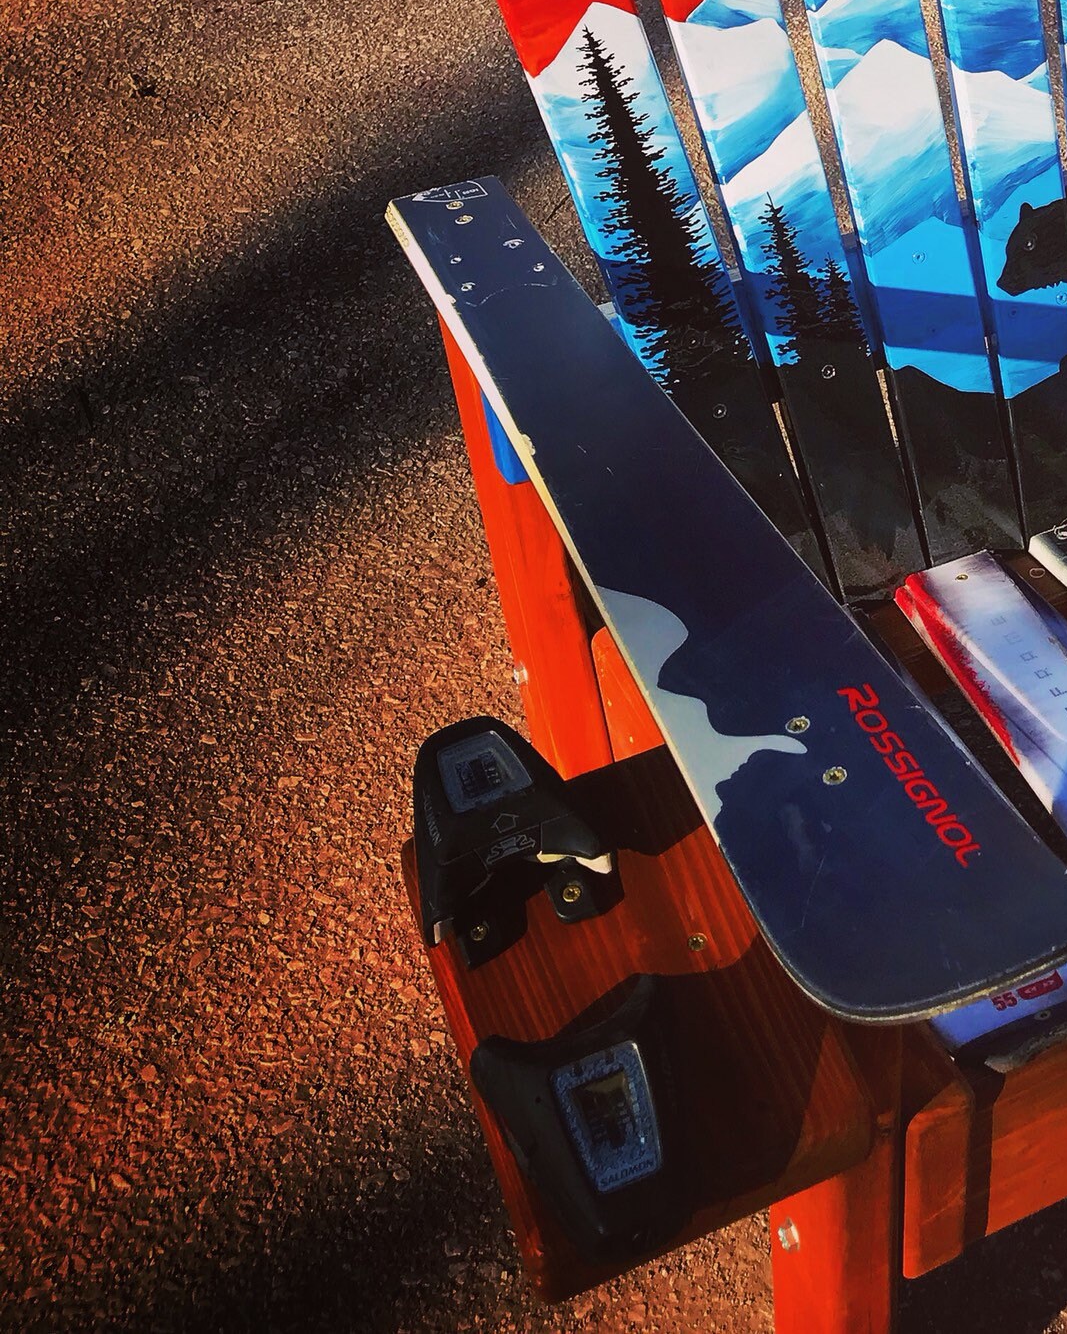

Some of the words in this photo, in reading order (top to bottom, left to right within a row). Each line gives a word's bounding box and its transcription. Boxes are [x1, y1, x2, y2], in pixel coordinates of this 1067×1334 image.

[837, 682, 982, 868] ROSSIGNOL
[991, 990, 1018, 1012] 55
[599, 1160, 655, 1187] SALOMON
